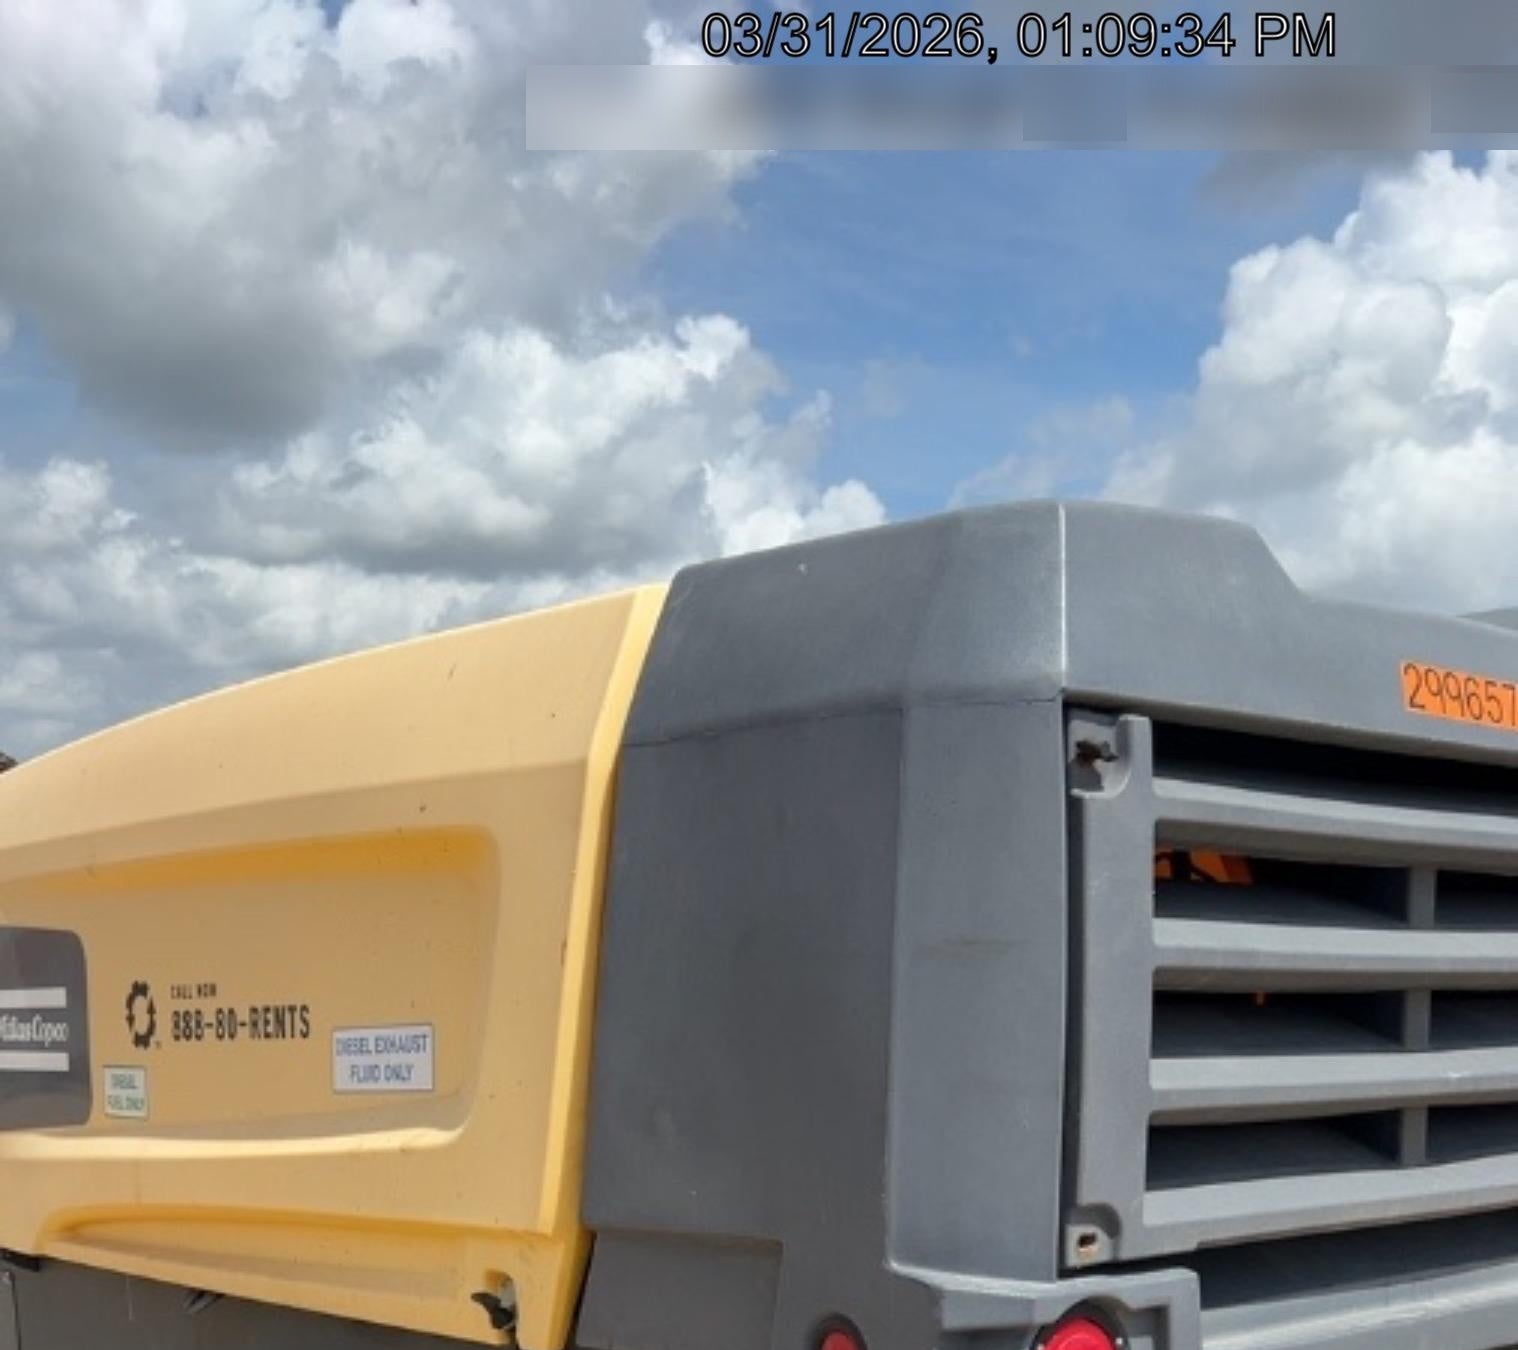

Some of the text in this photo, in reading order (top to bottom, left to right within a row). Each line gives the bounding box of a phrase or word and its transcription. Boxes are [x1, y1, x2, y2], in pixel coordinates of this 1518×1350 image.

[171, 1004, 310, 1041] 888-80-RENTS
[375, 1033, 430, 1054] EXHAUST
[350, 1064, 414, 1083] FLUID ONLY
